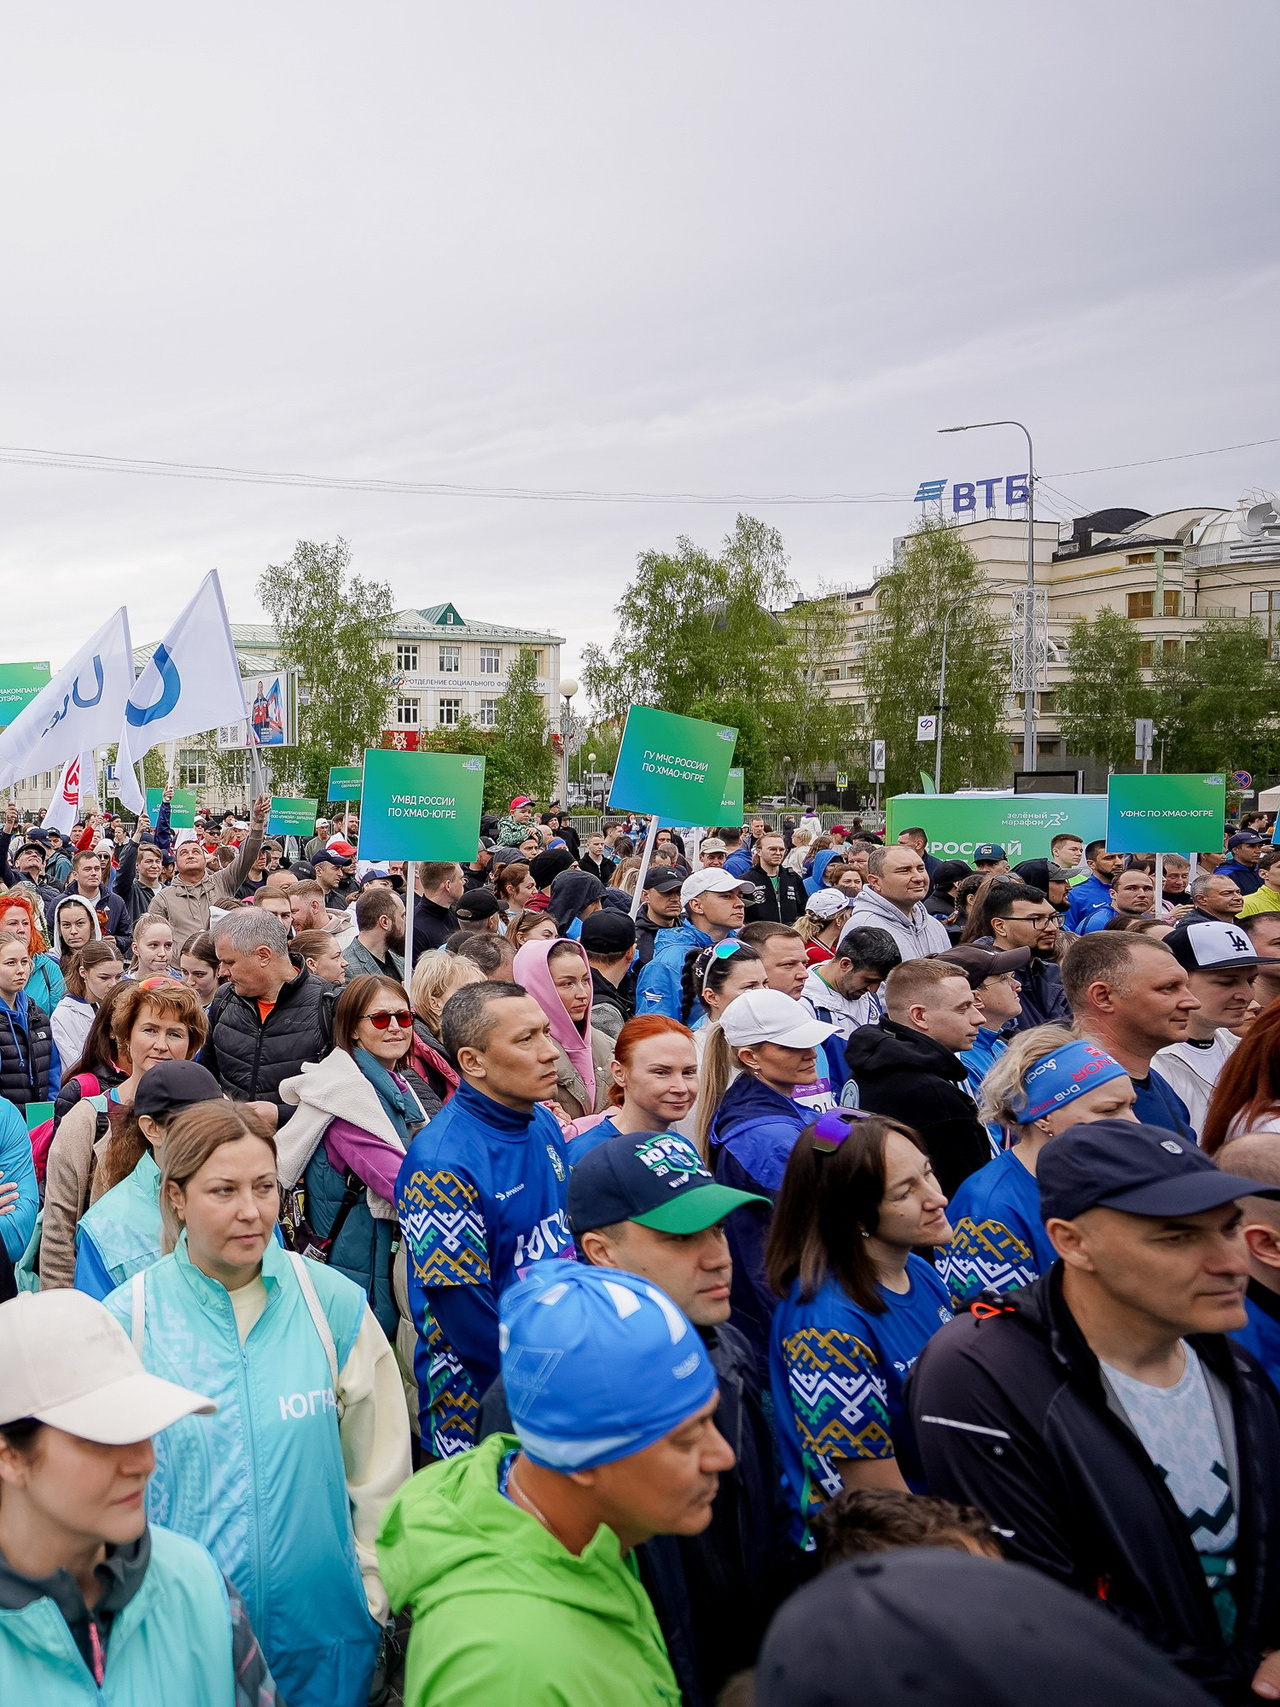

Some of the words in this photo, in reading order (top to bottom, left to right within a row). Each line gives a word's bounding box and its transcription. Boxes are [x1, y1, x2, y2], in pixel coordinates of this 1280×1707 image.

[953, 473, 1029, 513] ВТБ
[448, 679, 495, 688] СОЦИАЛЬНОГО
[643, 750, 655, 760] ГУ
[655, 752, 674, 765] МЧС
[674, 756, 708, 772] РОССИИ
[642, 762, 655, 773] ПО
[656, 764, 705, 784] ХМАО-ЮГРЕ
[391, 794, 417, 805] УМВД
[418, 796, 455, 806] РОССИИ
[388, 808, 402, 817] ПО
[403, 808, 456, 819] ХМАО-ЮГРЕ
[1006, 811, 1048, 819] зелёный
[1001, 818, 1044, 827] марафон
[1224, 931, 1249, 951] LA
